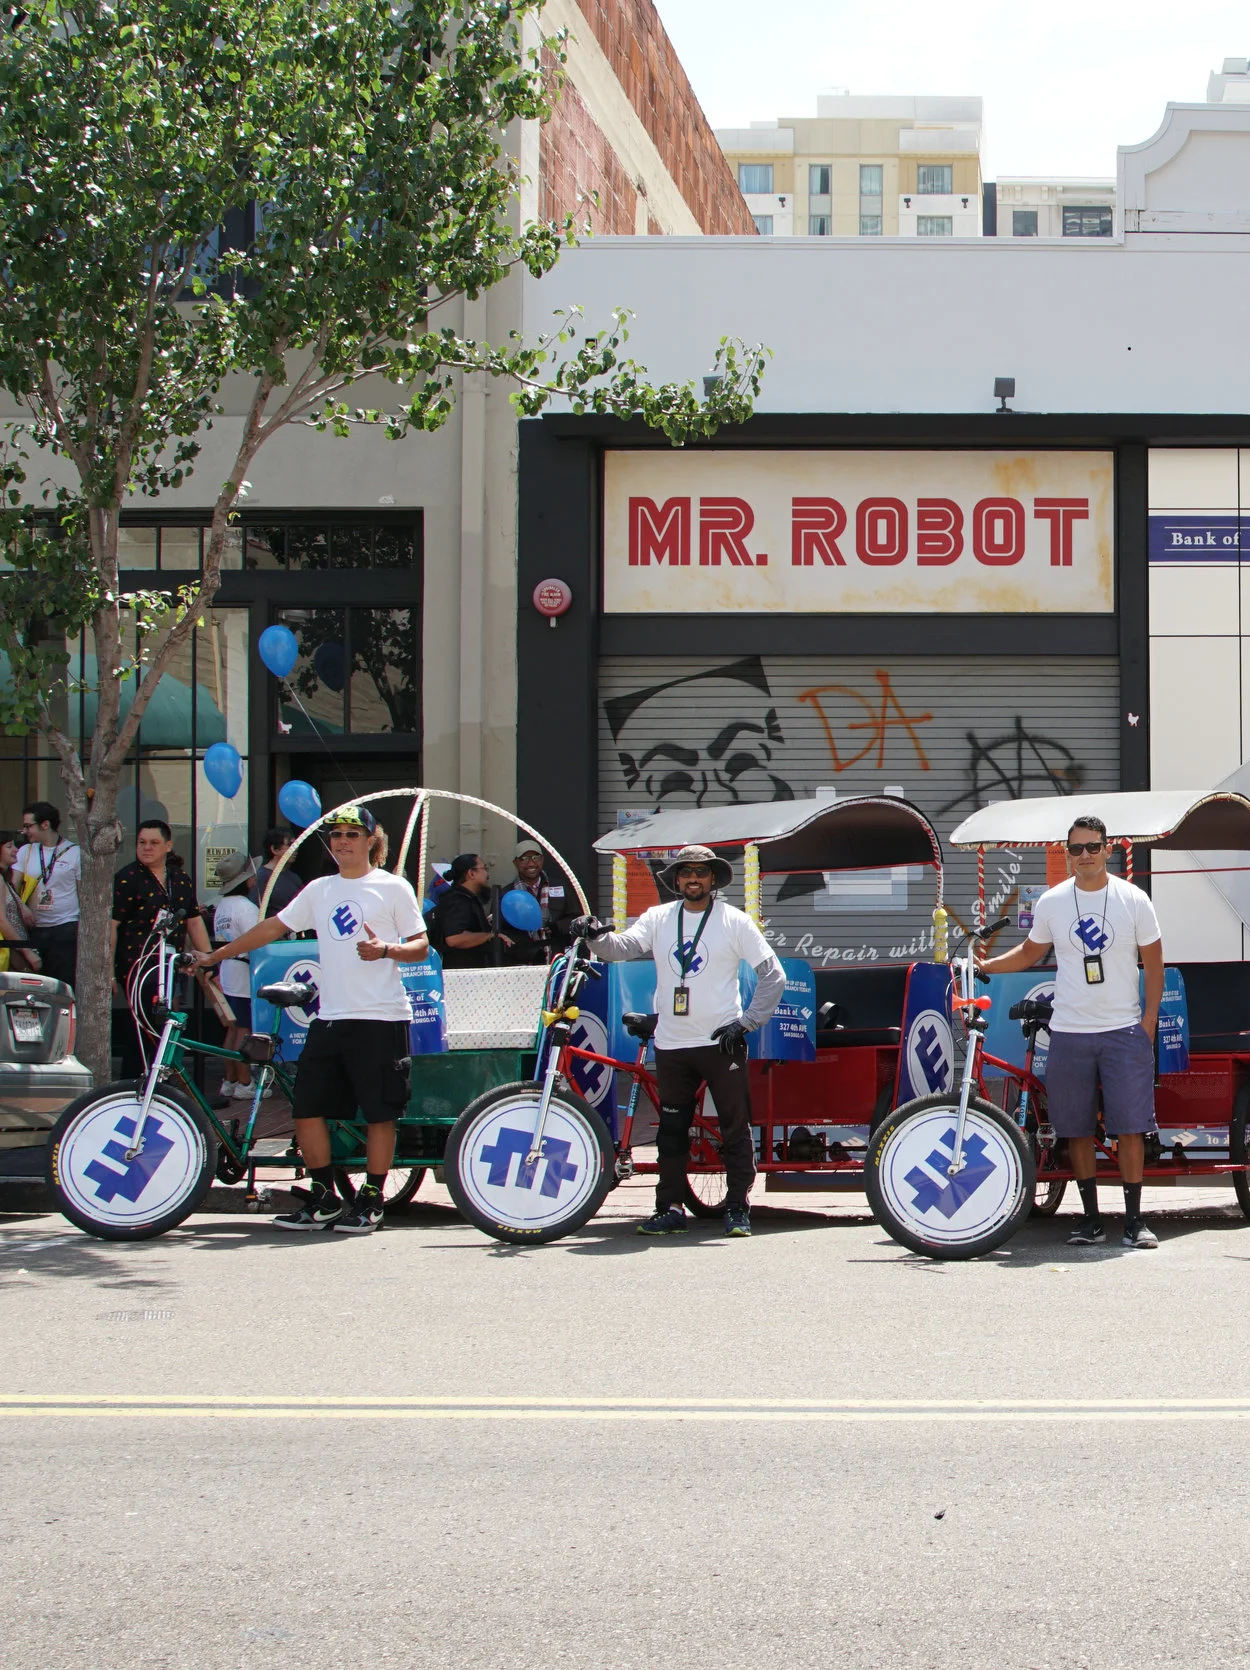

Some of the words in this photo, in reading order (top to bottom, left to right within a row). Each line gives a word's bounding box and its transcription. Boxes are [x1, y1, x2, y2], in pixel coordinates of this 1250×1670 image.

[628, 496, 768, 566] MR.
[791, 496, 1089, 567] ROBOT
[1171, 531, 1217, 546] Bank
[1222, 531, 1242, 546] of
[794, 932, 880, 967] Repair
[416, 993, 425, 1001] of
[415, 1009, 427, 1017] 4th
[427, 1007, 439, 1016] AVE
[779, 1022, 790, 1031] 327
[874, 1124, 895, 1167] MAXXIS
[52, 1142, 61, 1186] MAXXIS
